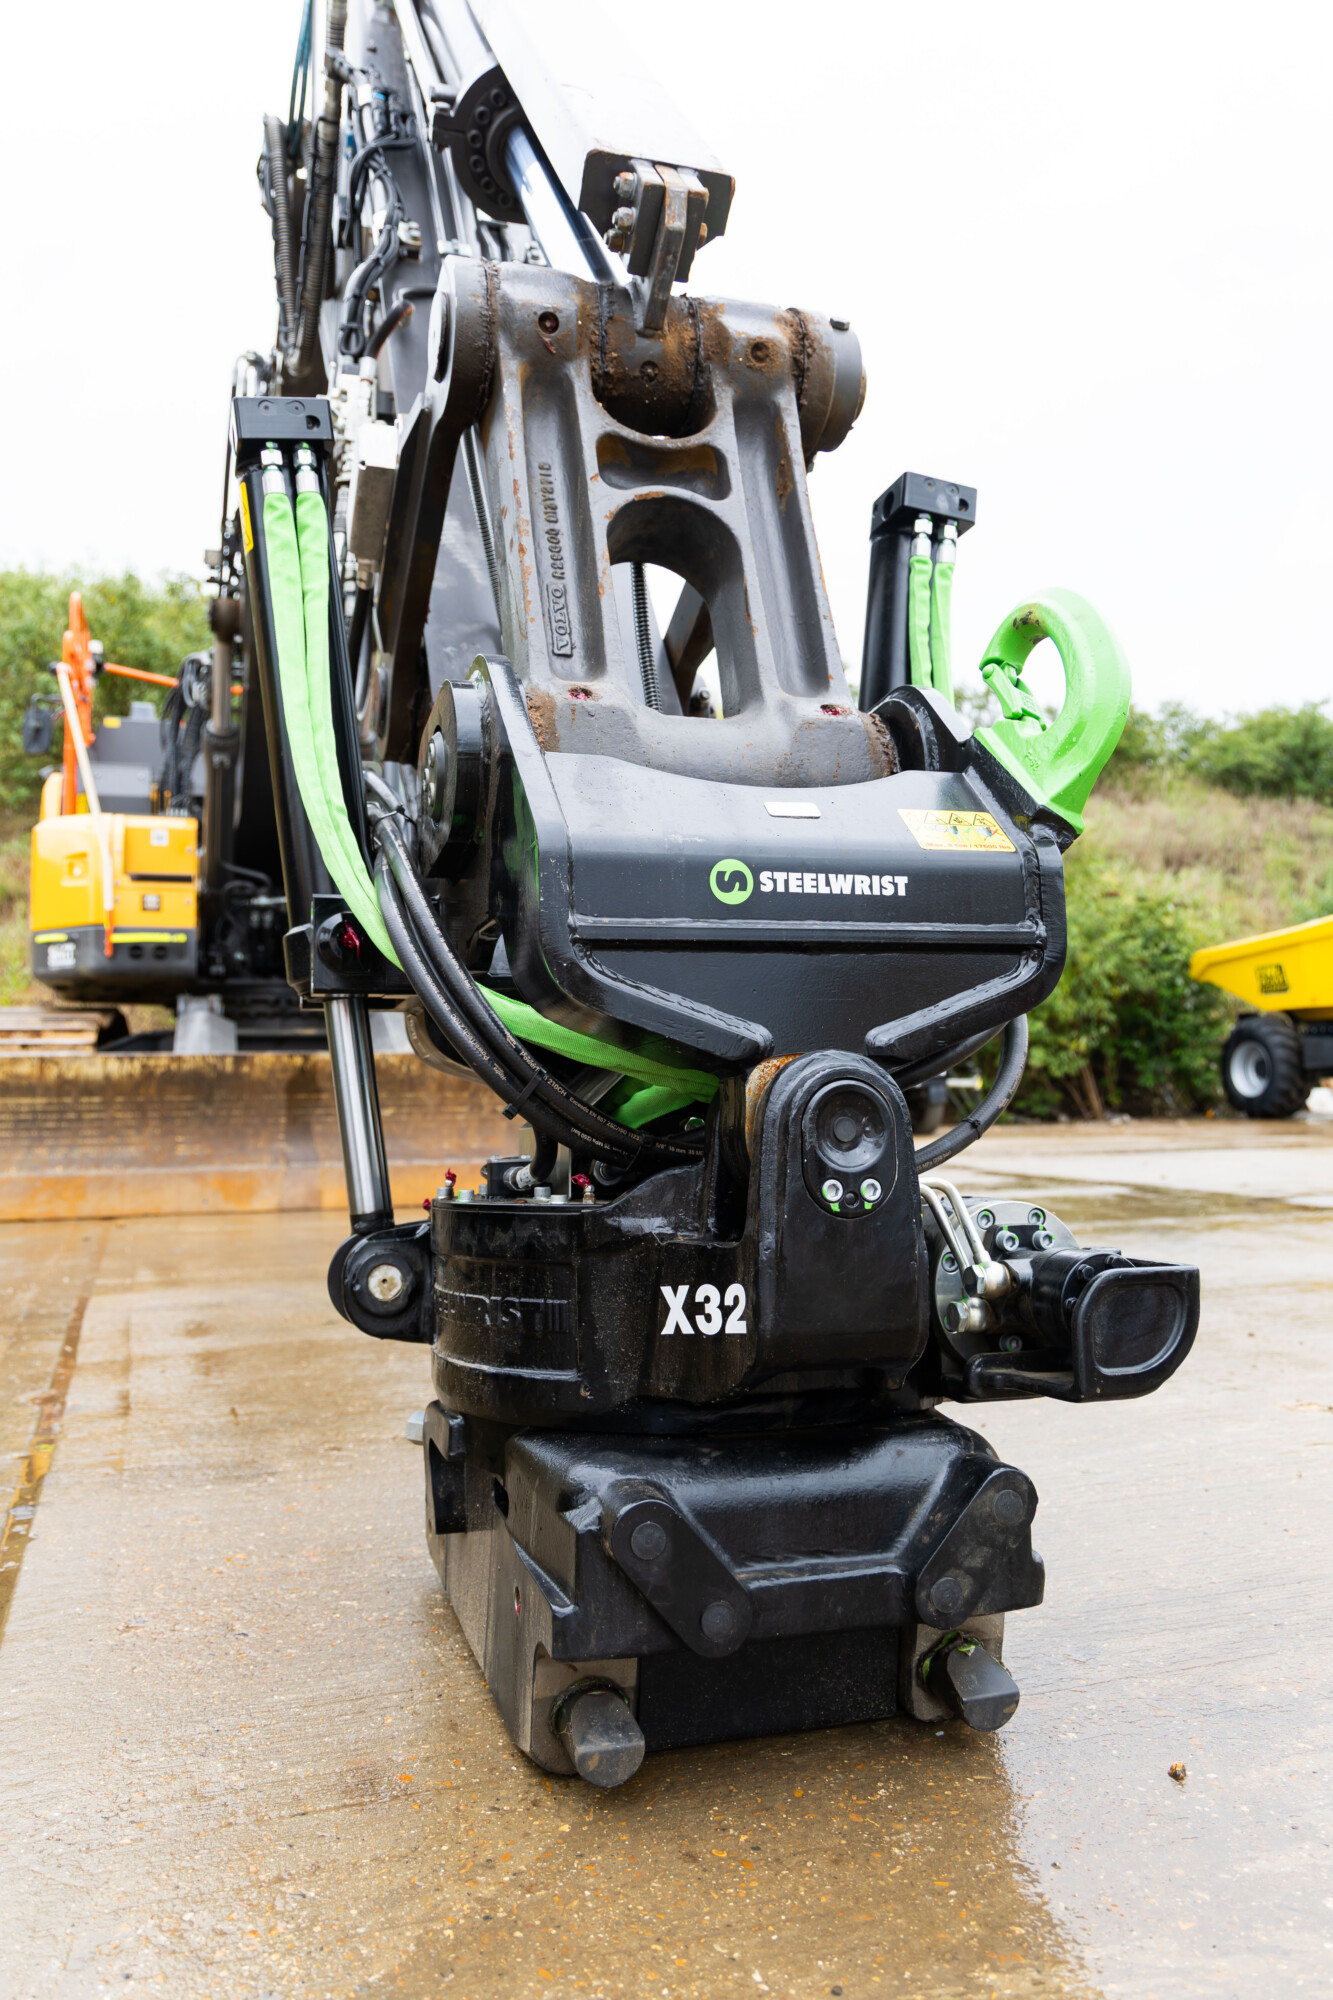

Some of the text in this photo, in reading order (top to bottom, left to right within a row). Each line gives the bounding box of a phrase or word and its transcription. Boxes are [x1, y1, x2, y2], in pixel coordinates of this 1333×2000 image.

[551, 586, 569, 651] VOLVO
[759, 870, 909, 897] STEELWRIST
[461, 1027, 490, 1061] PowerTech
[518, 1049, 549, 1081] PowerTh
[547, 1078, 567, 1097] 210CH
[567, 1096, 591, 1113] Exceeds
[660, 1283, 747, 1335] X32
